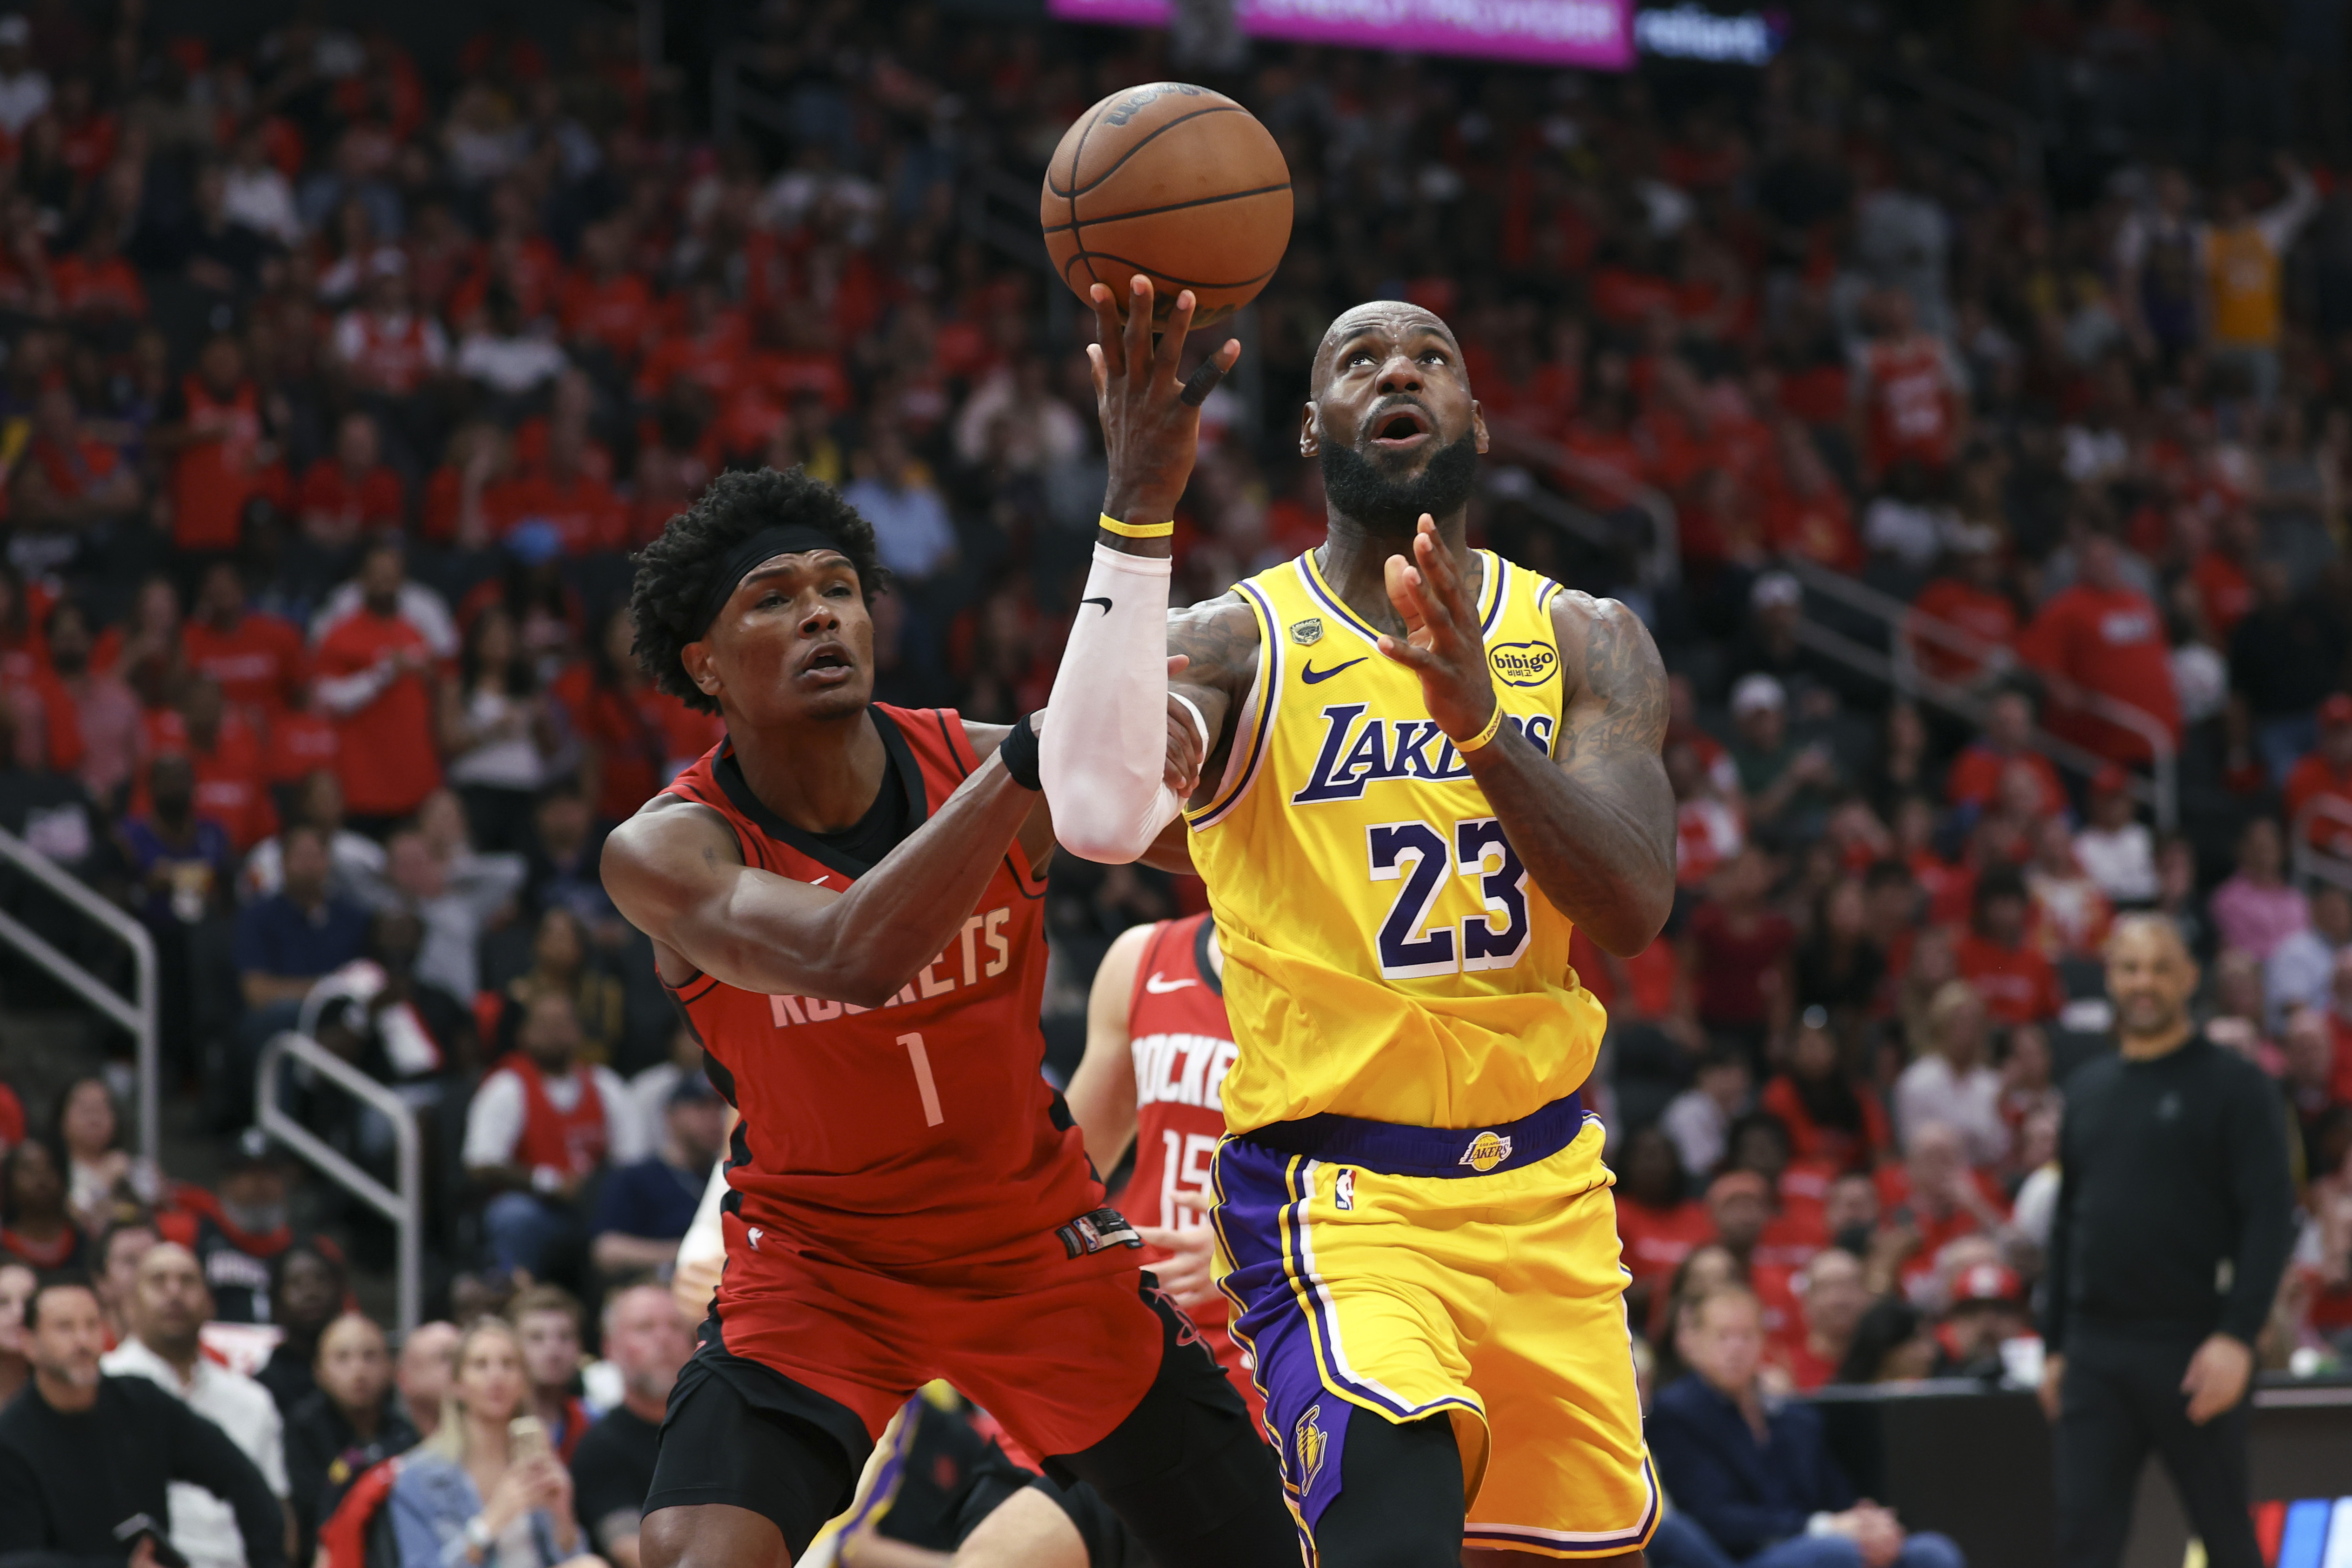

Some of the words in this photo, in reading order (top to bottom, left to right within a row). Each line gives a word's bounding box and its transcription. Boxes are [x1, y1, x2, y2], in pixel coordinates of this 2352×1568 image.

[1292, 619, 1317, 628] LEGACY
[1493, 653, 1553, 672] bibigo
[1290, 701, 1555, 806] LAKS
[1365, 816, 1532, 980] 23
[896, 1032, 944, 1127] 1
[1131, 1033, 1239, 1113] OCKE
[1160, 1128, 1218, 1233] 15
[1461, 1144, 1509, 1163] LAKERS
